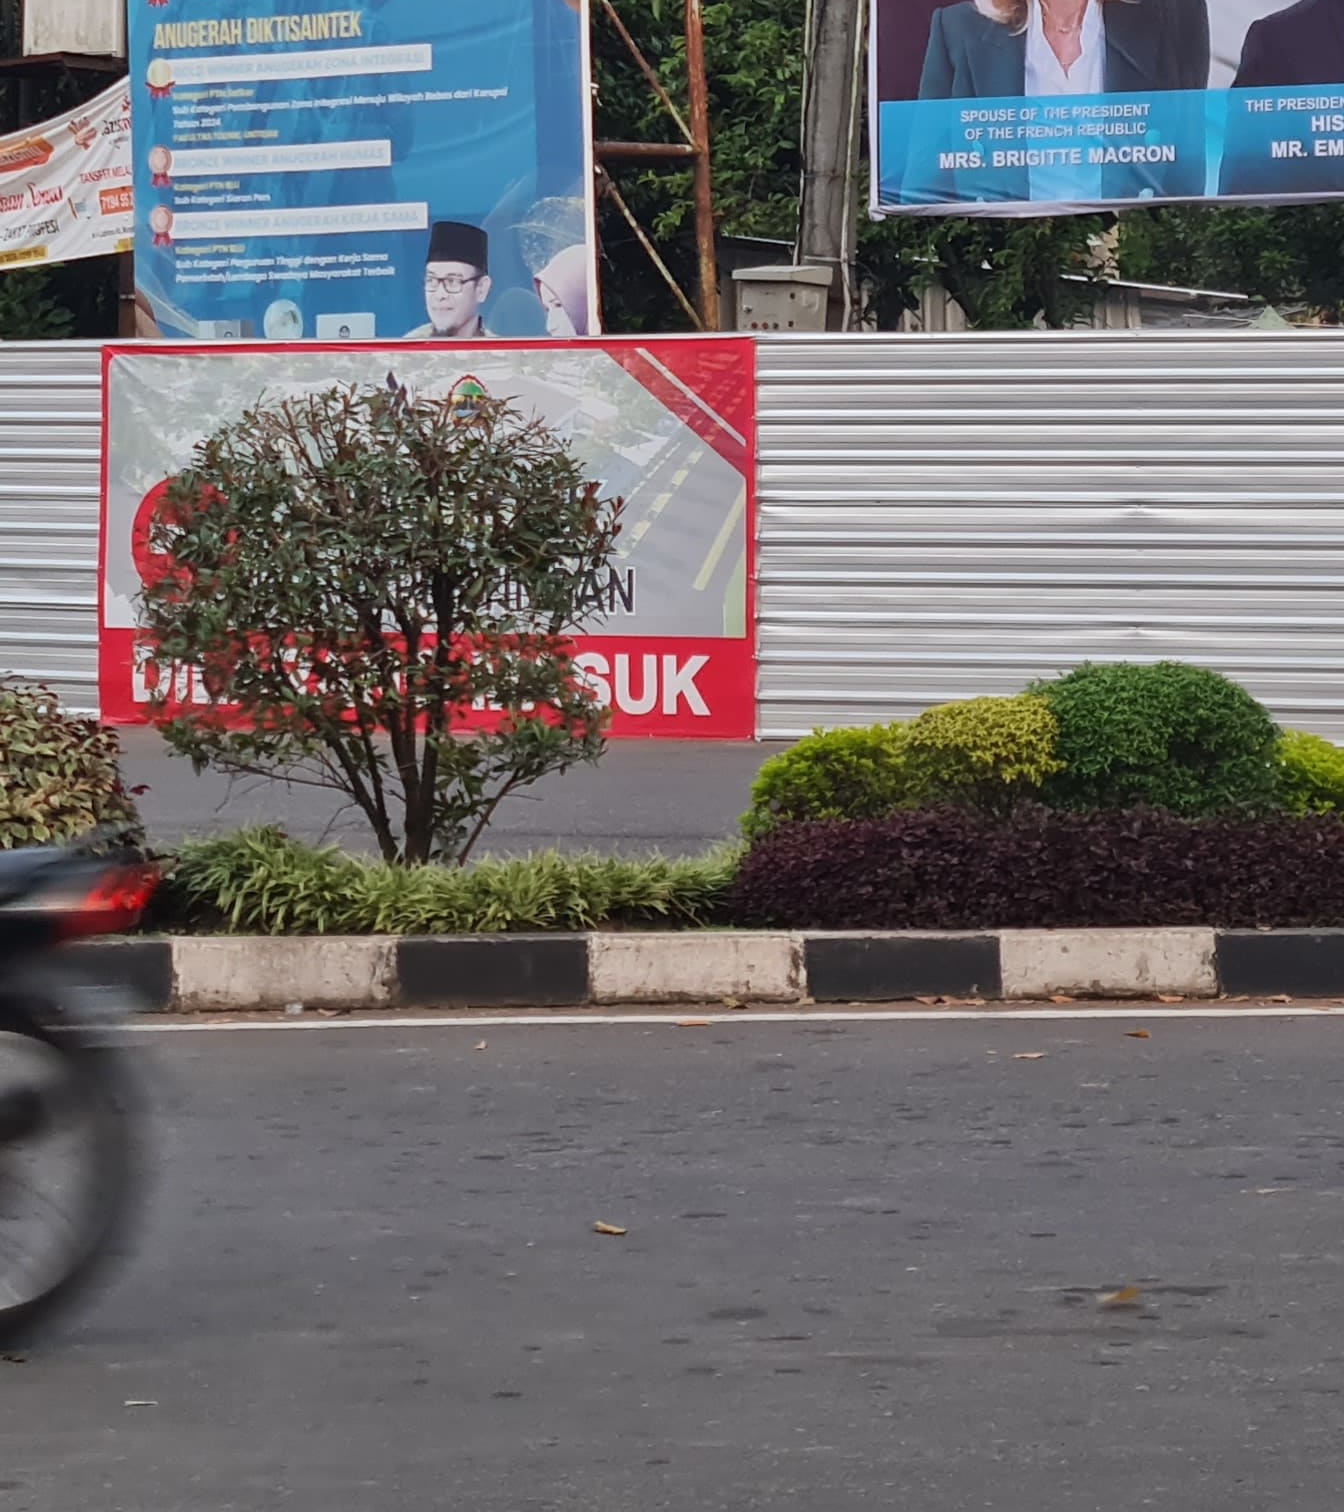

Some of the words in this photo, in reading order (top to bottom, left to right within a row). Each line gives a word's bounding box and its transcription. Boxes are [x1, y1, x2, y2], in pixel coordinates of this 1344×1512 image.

[154, 18, 242, 50] ANUGERAH
[246, 10, 362, 44] DIKTISAINTEK
[960, 108, 1017, 123] SPOUSE
[1020, 107, 1038, 121] OF
[1044, 106, 1069, 120] THE
[1072, 103, 1151, 119] PRESIDENT
[1245, 99, 1273, 112] THE
[965, 127, 984, 141] OF
[987, 126, 1013, 140] THE
[1017, 124, 1073, 139] FRENCH
[1077, 121, 1146, 137] REPUBLIC
[1311, 114, 1344, 133] HIS
[939, 151, 986, 170] MRS.
[992, 147, 1082, 168] BRIGITTE
[1088, 144, 1176, 165] MACRON
[1271, 140, 1308, 159] MR.
